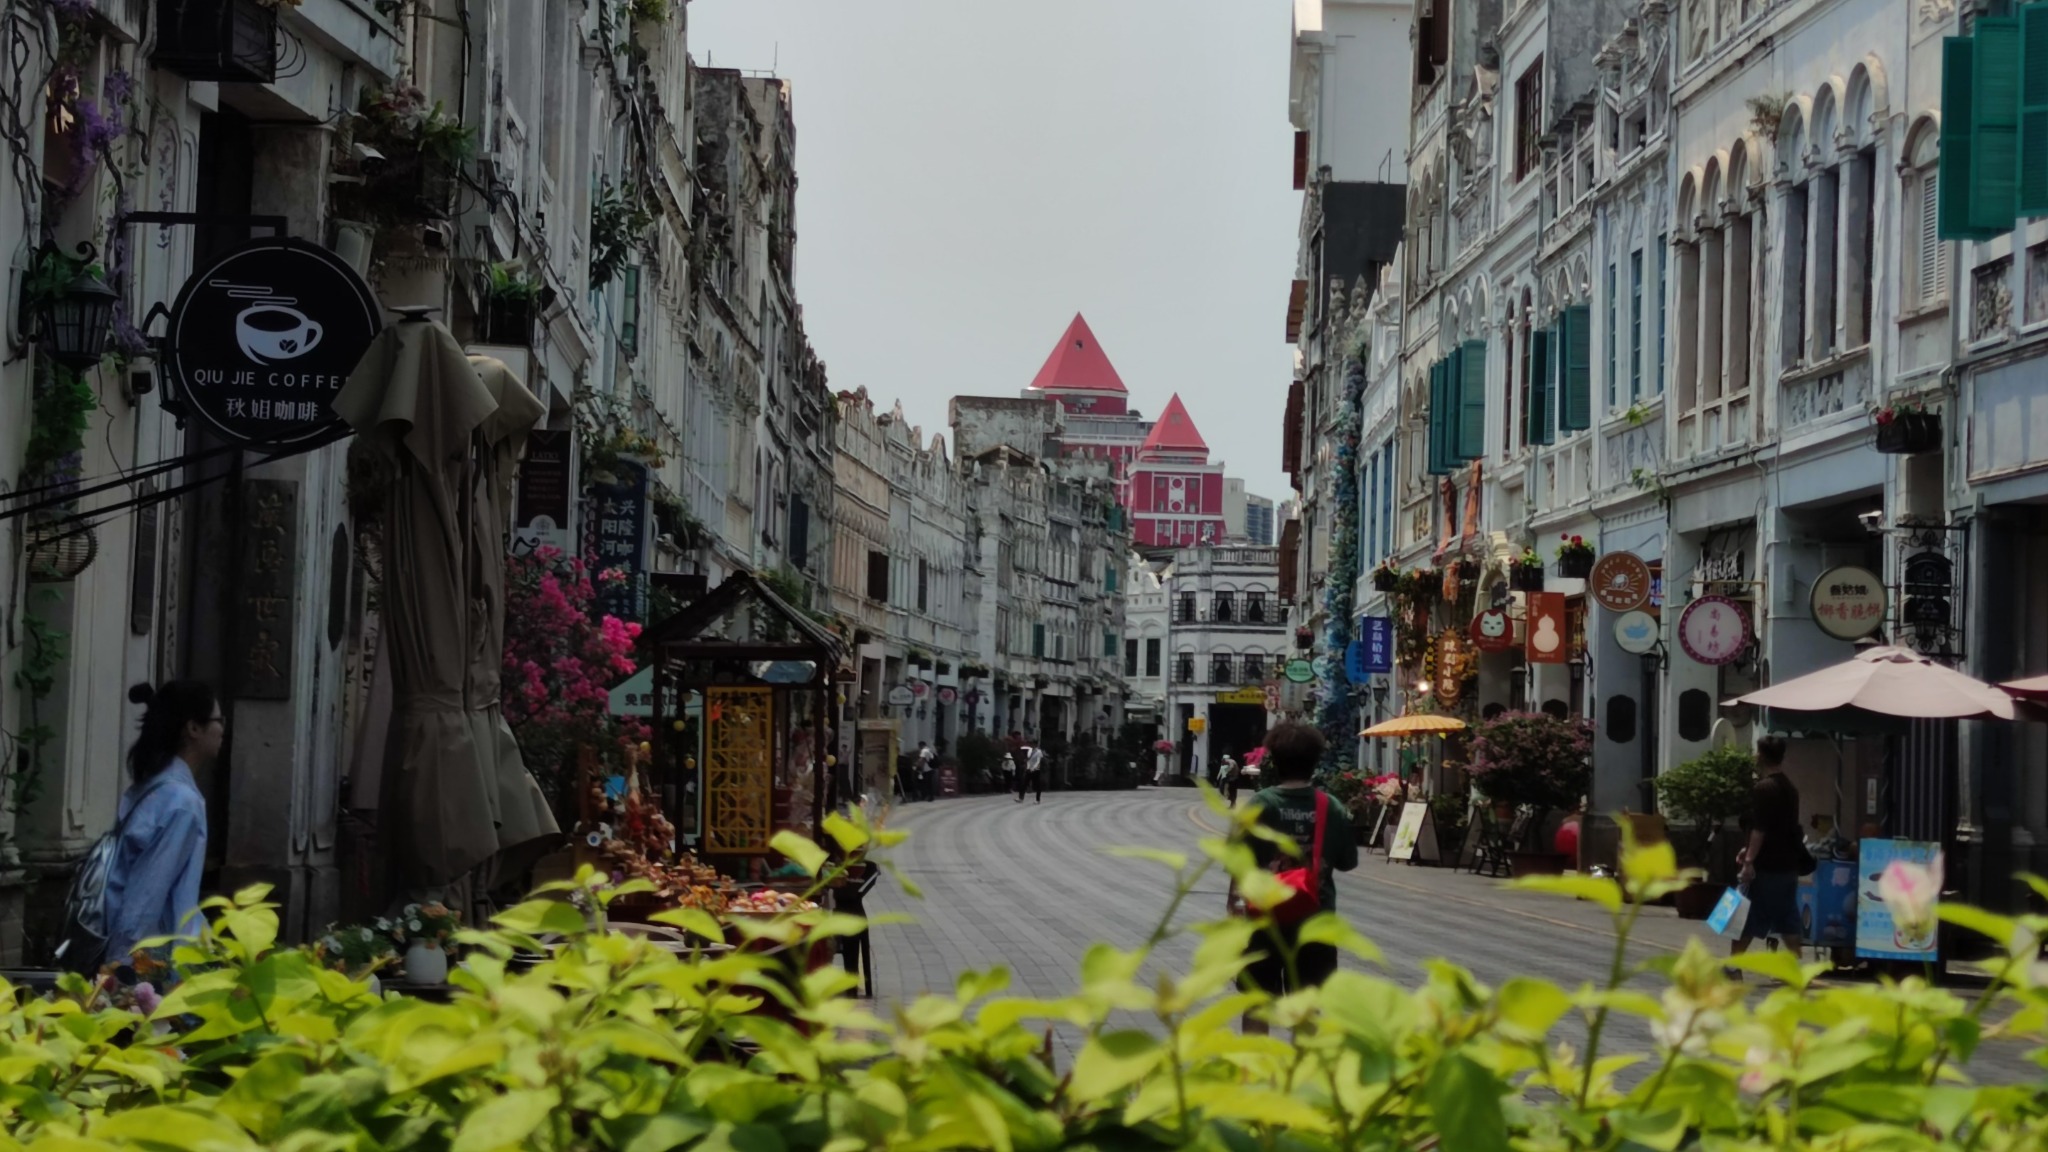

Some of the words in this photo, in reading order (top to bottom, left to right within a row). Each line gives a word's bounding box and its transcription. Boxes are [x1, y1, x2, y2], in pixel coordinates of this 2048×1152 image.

[194, 368, 224, 387] QIU
[231, 371, 256, 386] JIE
[226, 397, 320, 422] 秋姐咖啡
[600, 497, 619, 557] 太阳河
